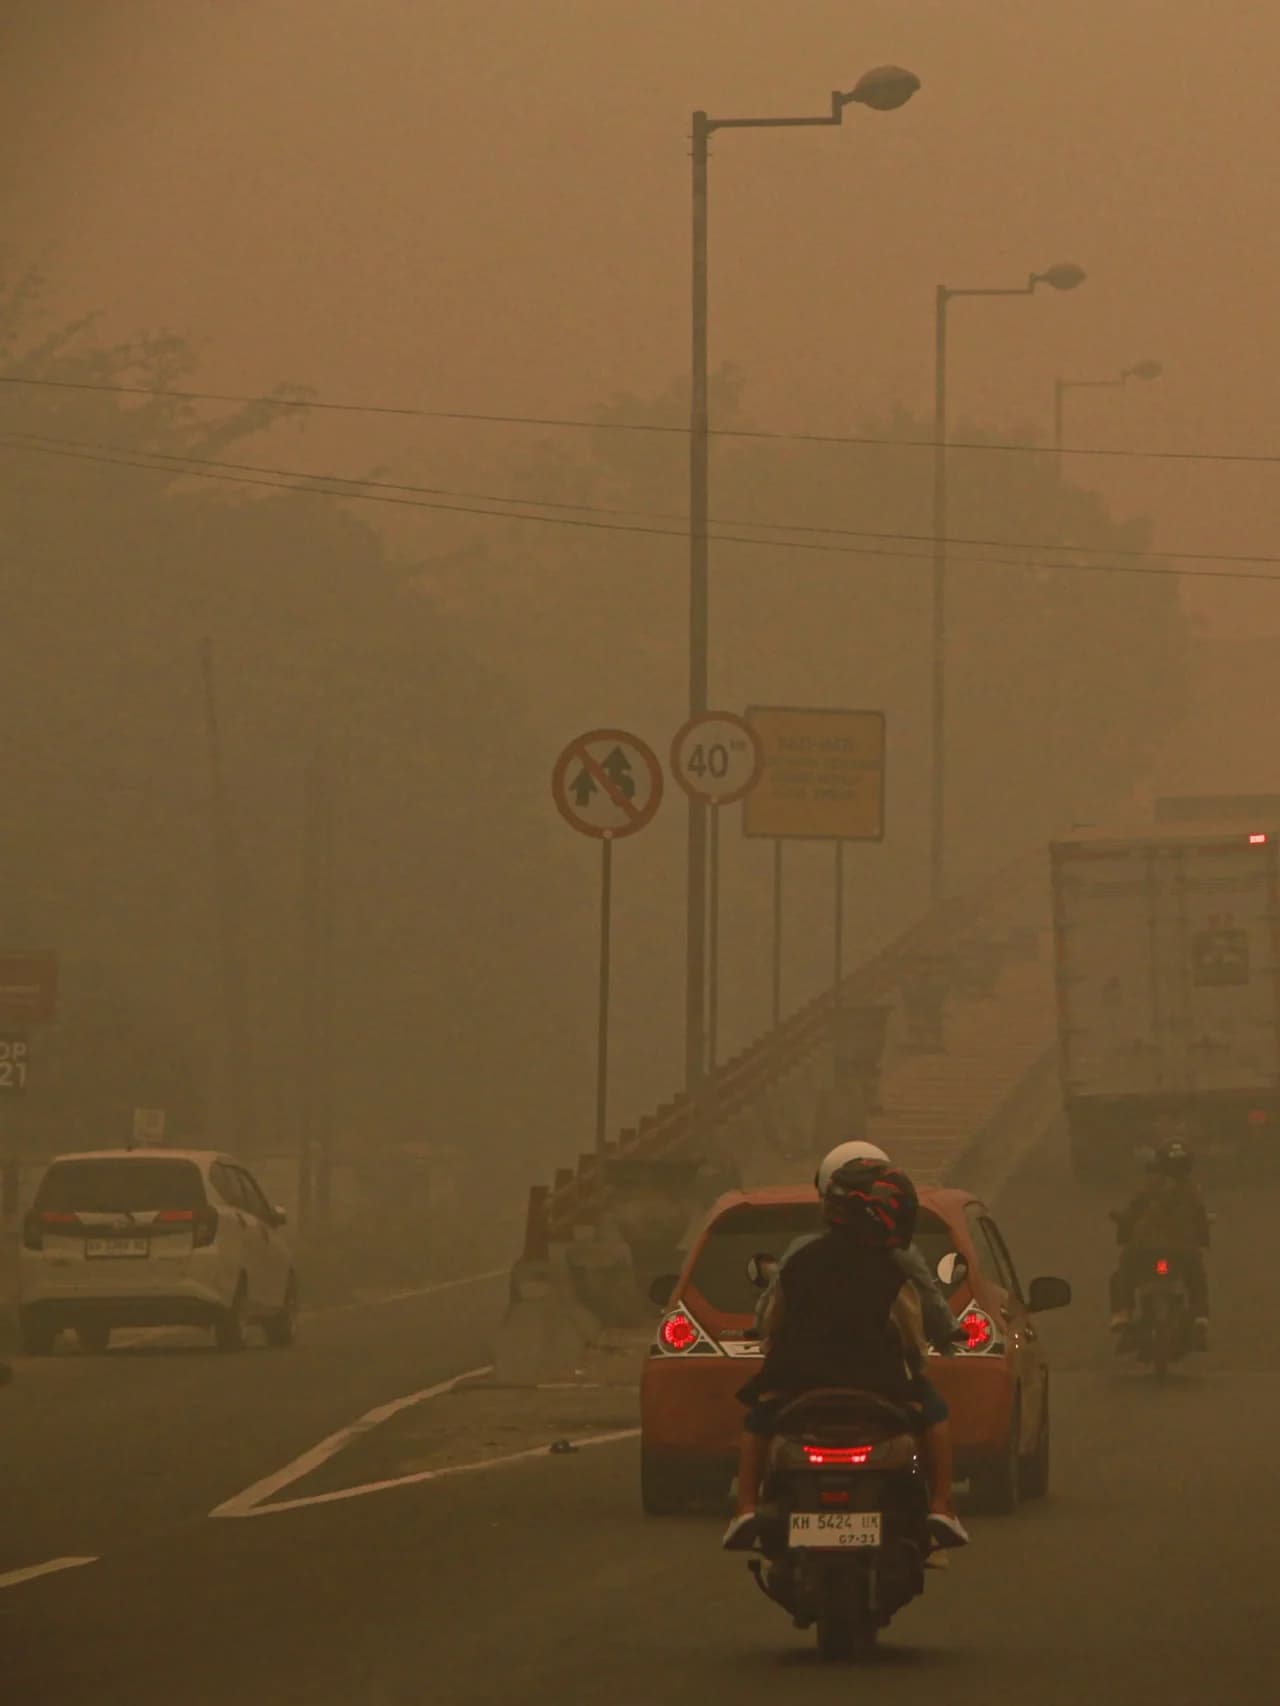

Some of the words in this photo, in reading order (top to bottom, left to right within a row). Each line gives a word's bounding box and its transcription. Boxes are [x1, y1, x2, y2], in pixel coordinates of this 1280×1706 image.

[688, 744, 729, 778] 40
[792, 1516, 809, 1529] KH
[818, 1514, 852, 1529] 5424
